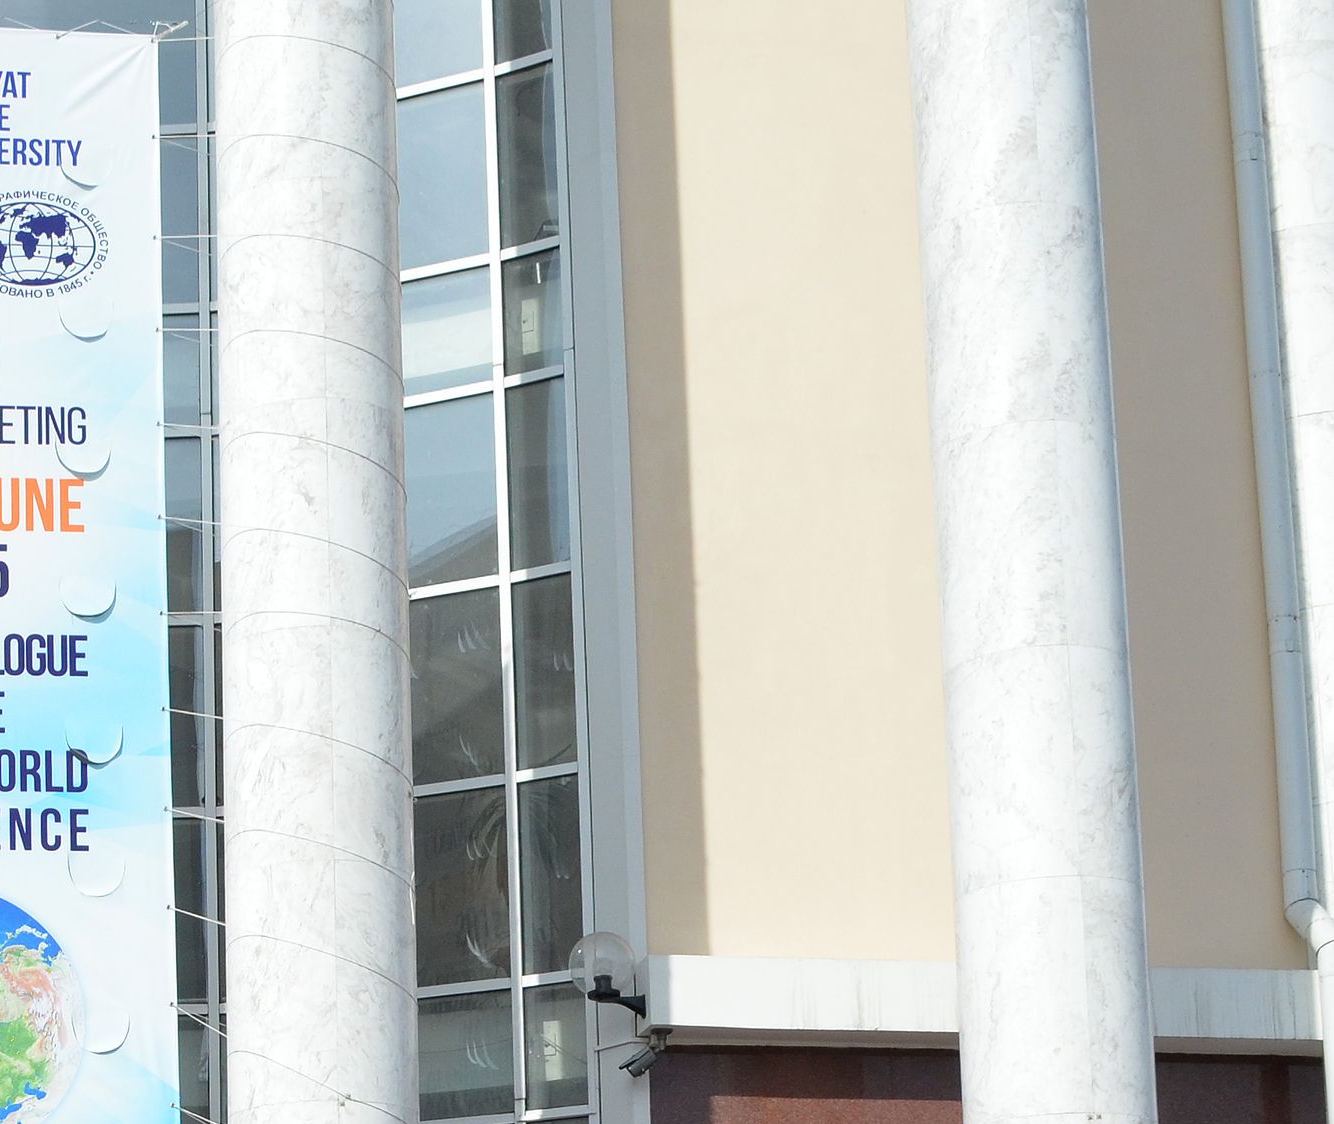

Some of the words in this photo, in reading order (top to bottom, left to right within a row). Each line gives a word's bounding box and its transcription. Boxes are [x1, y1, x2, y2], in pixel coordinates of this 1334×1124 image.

[80, 208, 108, 270] ОБЩЕСТВО
[46, 288, 55, 298] В
[57, 280, 84, 296] 1845
